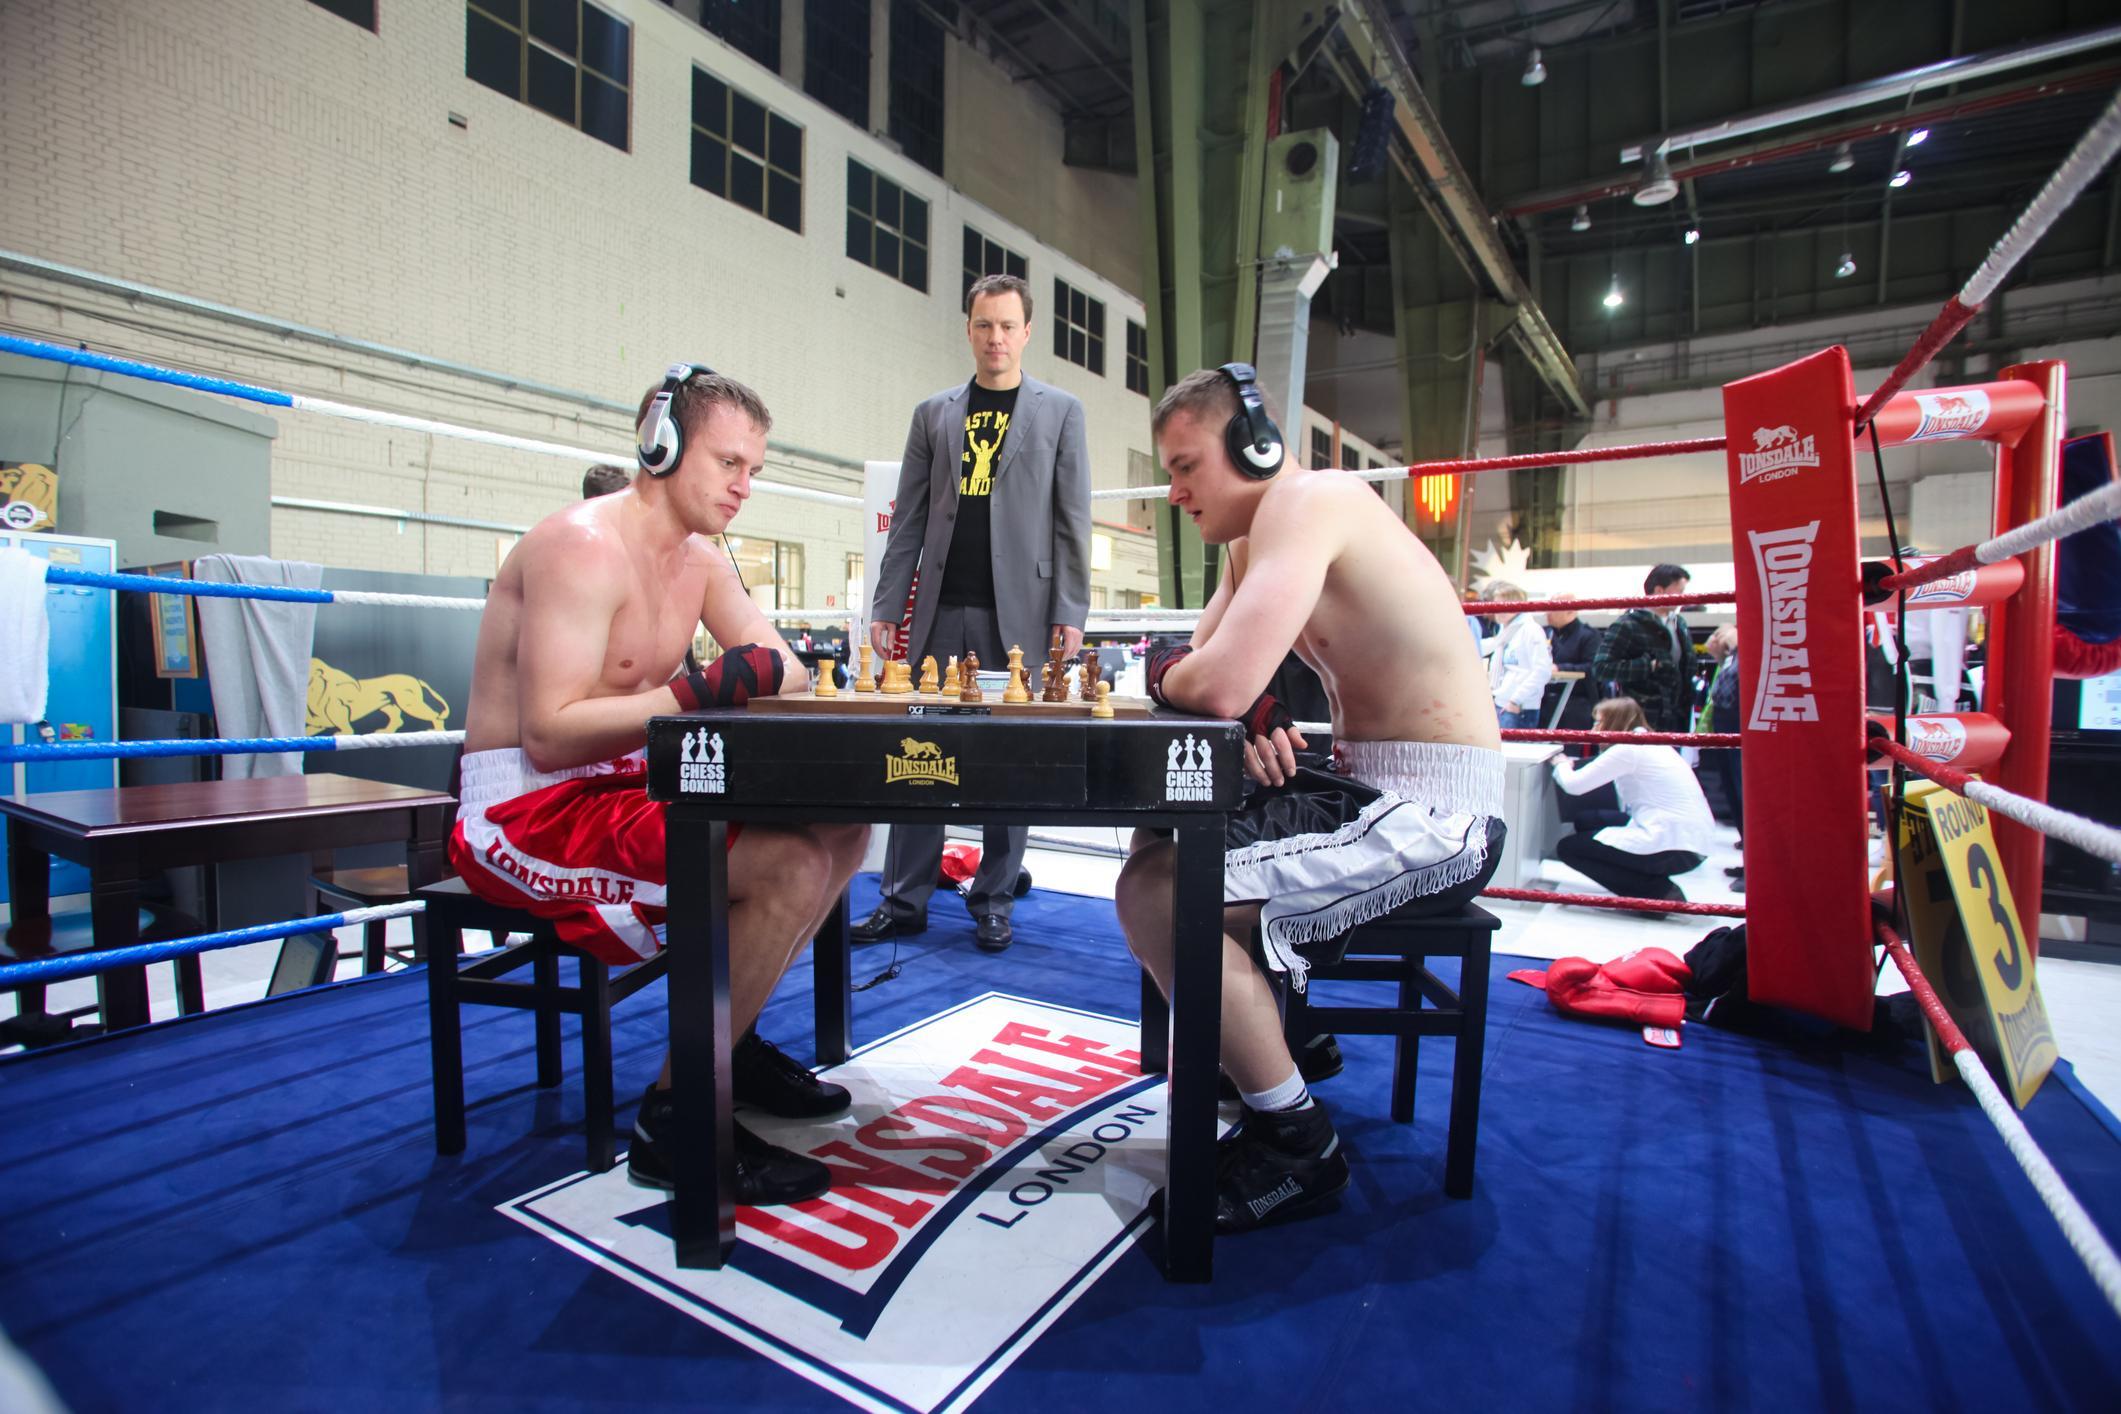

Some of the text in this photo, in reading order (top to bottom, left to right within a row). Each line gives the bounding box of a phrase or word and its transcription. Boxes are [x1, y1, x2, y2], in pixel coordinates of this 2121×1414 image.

[1739, 434, 1820, 485] LONSDALE
[1759, 467, 1799, 483] LONDON
[1748, 520, 1820, 732] LONSDALE
[680, 763, 725, 780] CHESS
[680, 779, 725, 794] BOXING
[885, 753, 960, 786] LONSDALE
[1166, 771, 1213, 787] CHESS
[1165, 787, 1213, 802] BOXING
[1934, 798, 1985, 843] ROUND
[485, 835, 635, 905] LONSDALE
[1966, 843, 2023, 991] 3
[976, 1104, 1157, 1229] LONDON
[1247, 1176, 1304, 1220] LONSDALE
